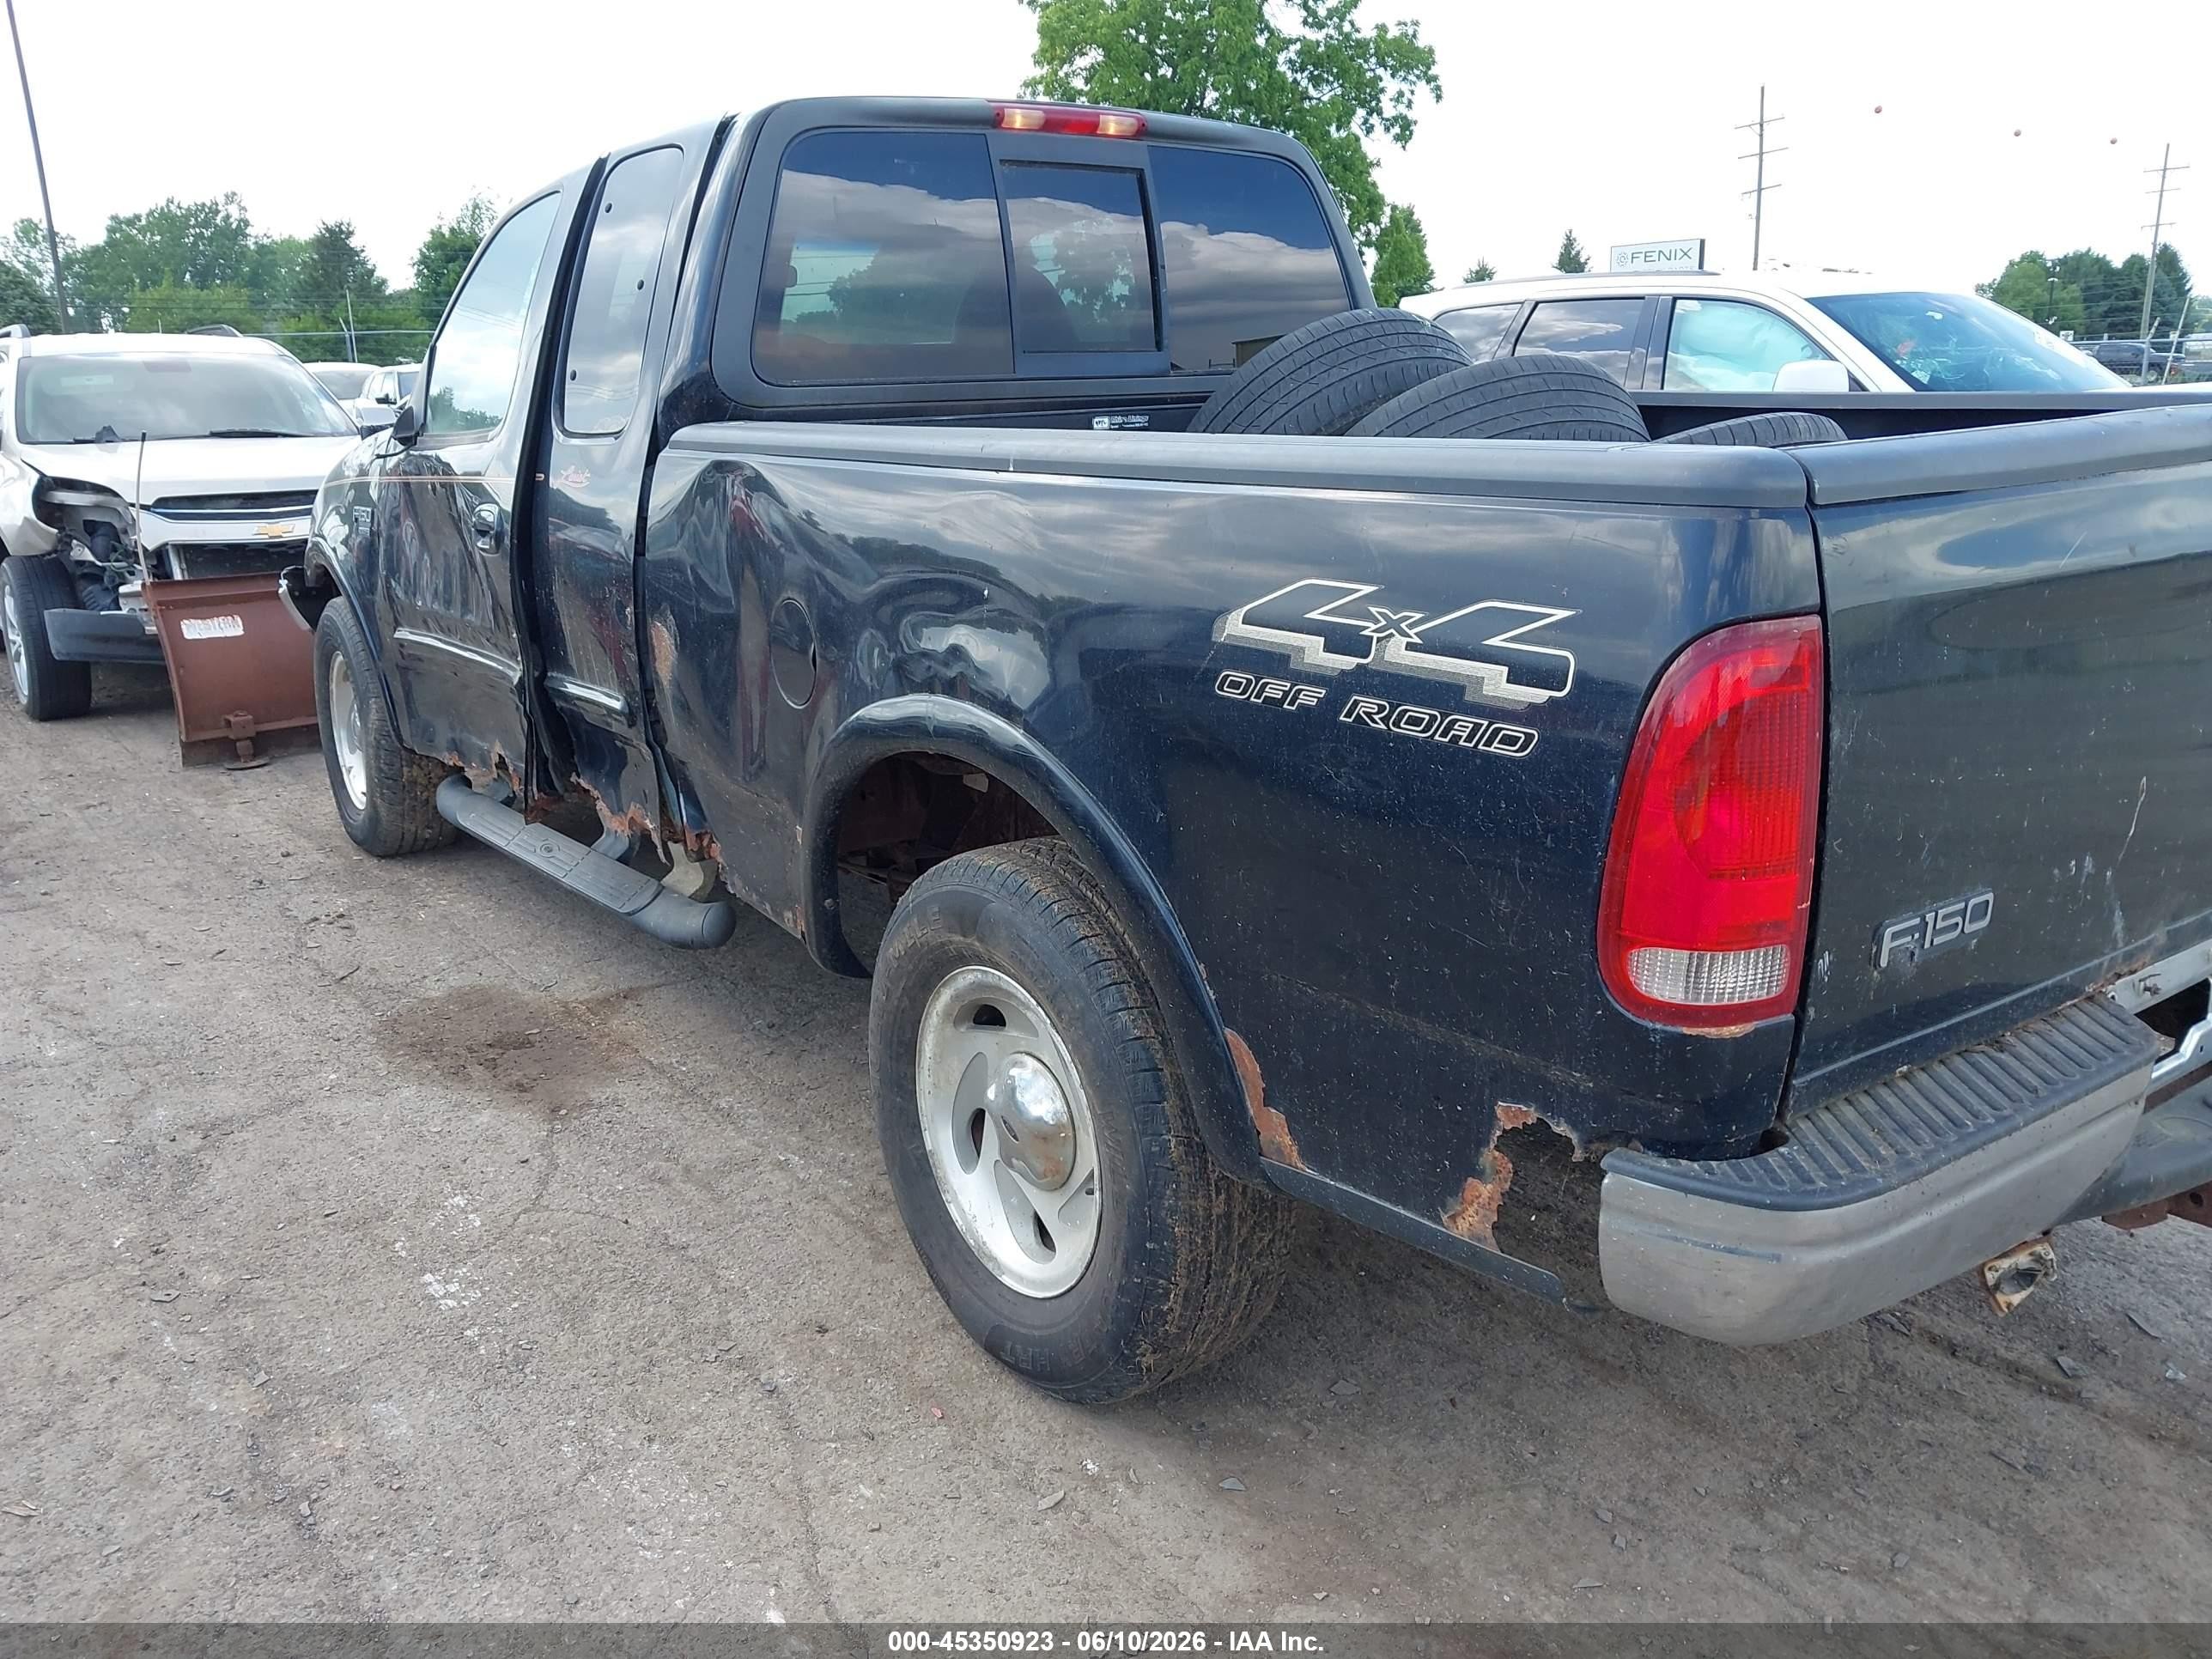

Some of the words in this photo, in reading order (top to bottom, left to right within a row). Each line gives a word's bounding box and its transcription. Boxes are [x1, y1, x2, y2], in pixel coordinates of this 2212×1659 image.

[1631, 247, 1692, 264] FENIX
[1214, 669, 1328, 711] OFF
[1338, 695, 1540, 758] ROAD
